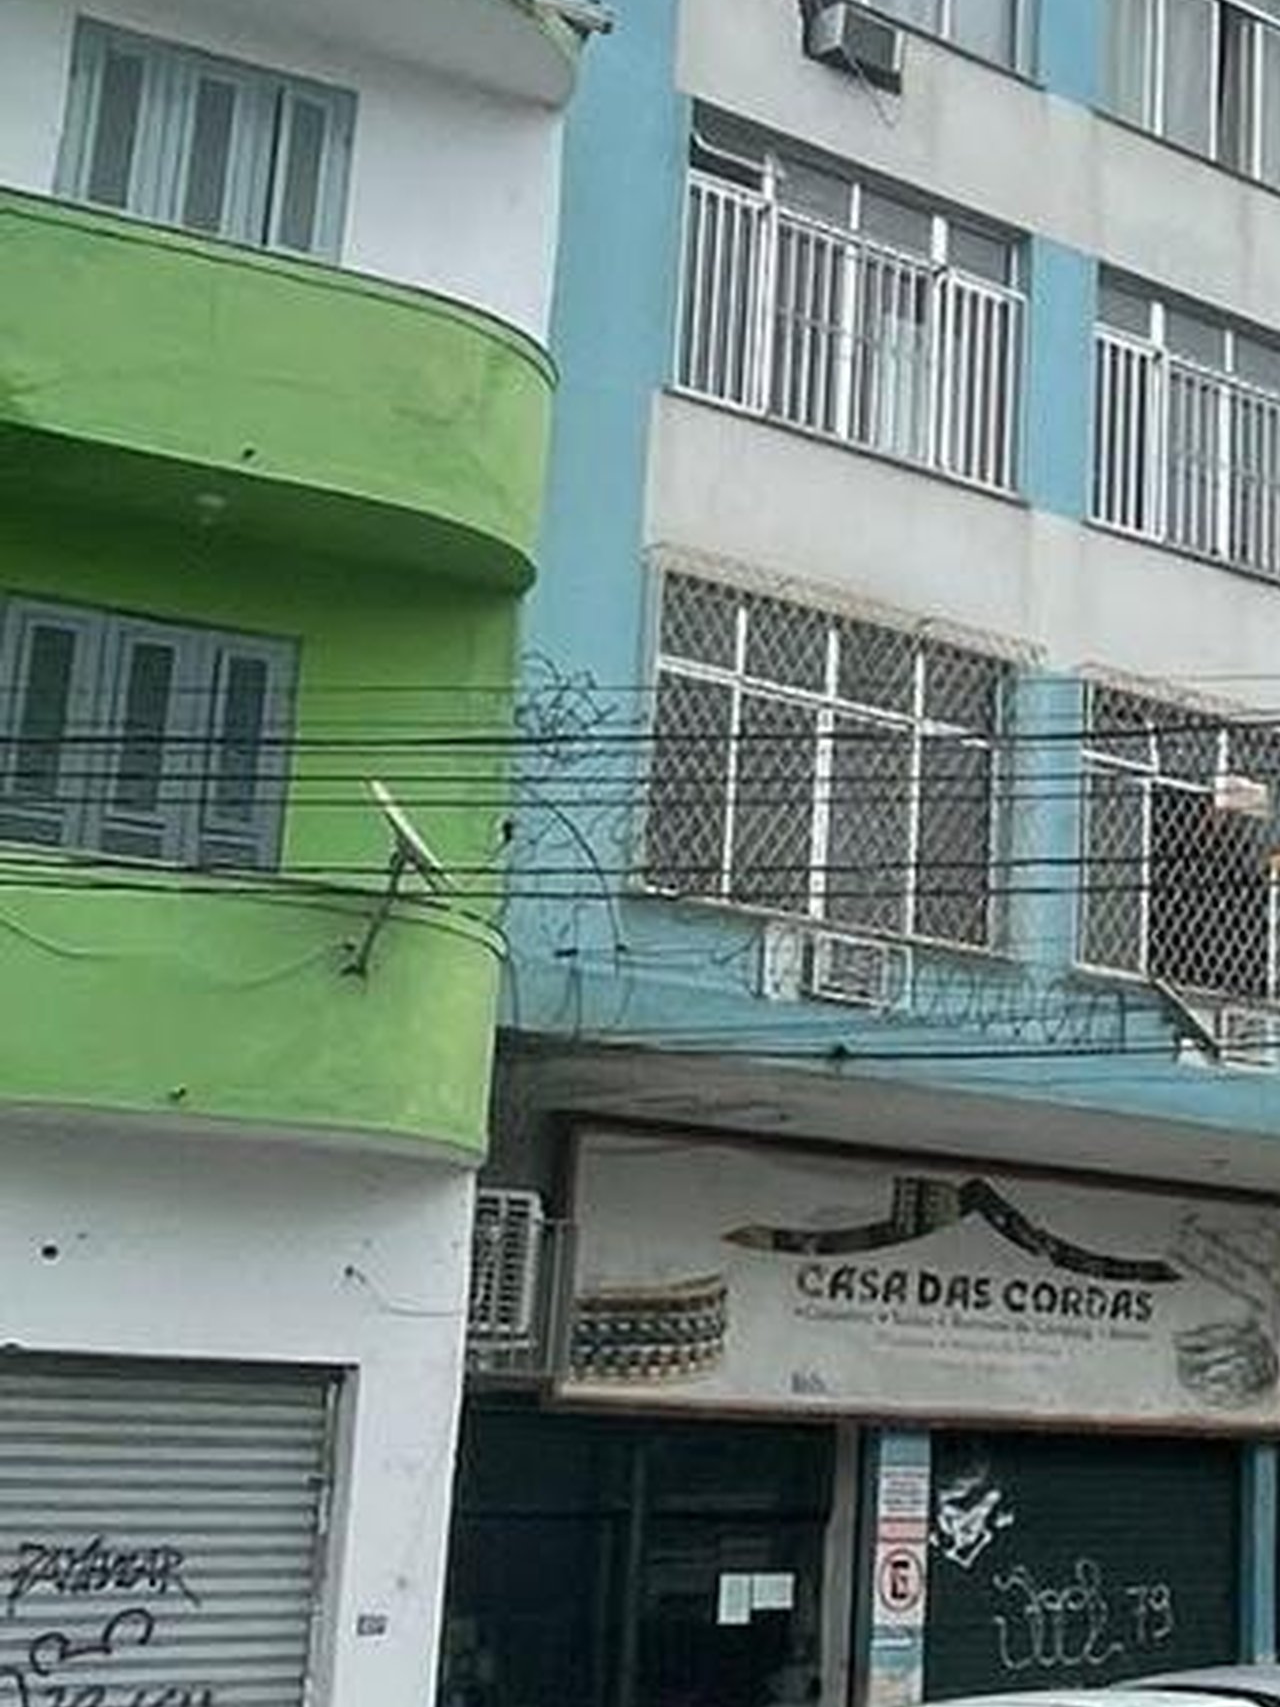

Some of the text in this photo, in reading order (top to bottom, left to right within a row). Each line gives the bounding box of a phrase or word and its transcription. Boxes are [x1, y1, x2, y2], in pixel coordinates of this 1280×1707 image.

[796, 1263, 908, 1304] CASA
[917, 1270, 993, 1311] DAS
[1001, 1278, 1154, 1322] CORDAS
